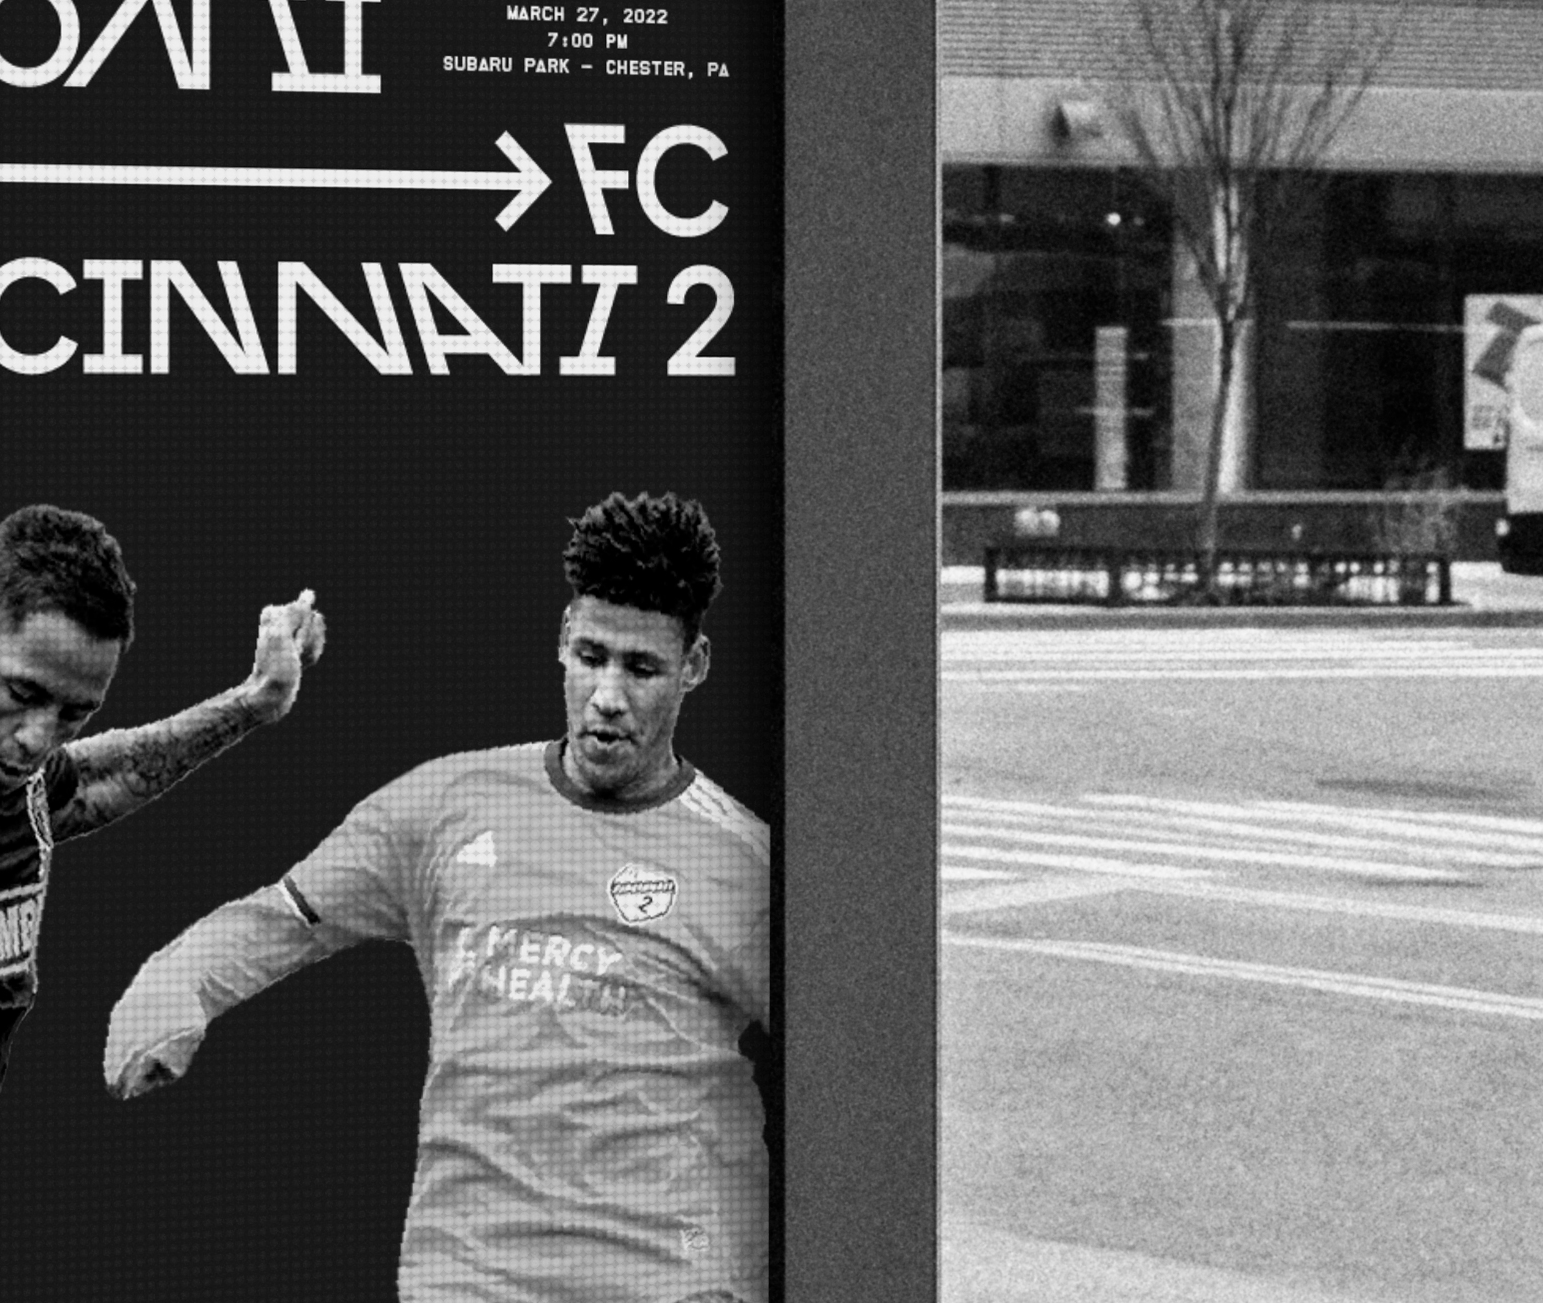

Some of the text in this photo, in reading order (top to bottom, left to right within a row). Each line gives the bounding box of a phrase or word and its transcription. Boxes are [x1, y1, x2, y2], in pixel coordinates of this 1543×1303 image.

[507, 6, 667, 25] MARCH 27, 2022
[548, 33, 628, 48] 7:00 PM
[444, 56, 512, 72] SUBARU
[525, 58, 569, 73] PARK
[607, 60, 692, 79] CHESTER,
[708, 62, 729, 76] PA
[565, 124, 728, 237] FC
[667, 265, 735, 375] 2
[486, 925, 623, 976] MERCY
[481, 964, 627, 1016] HEALTH
